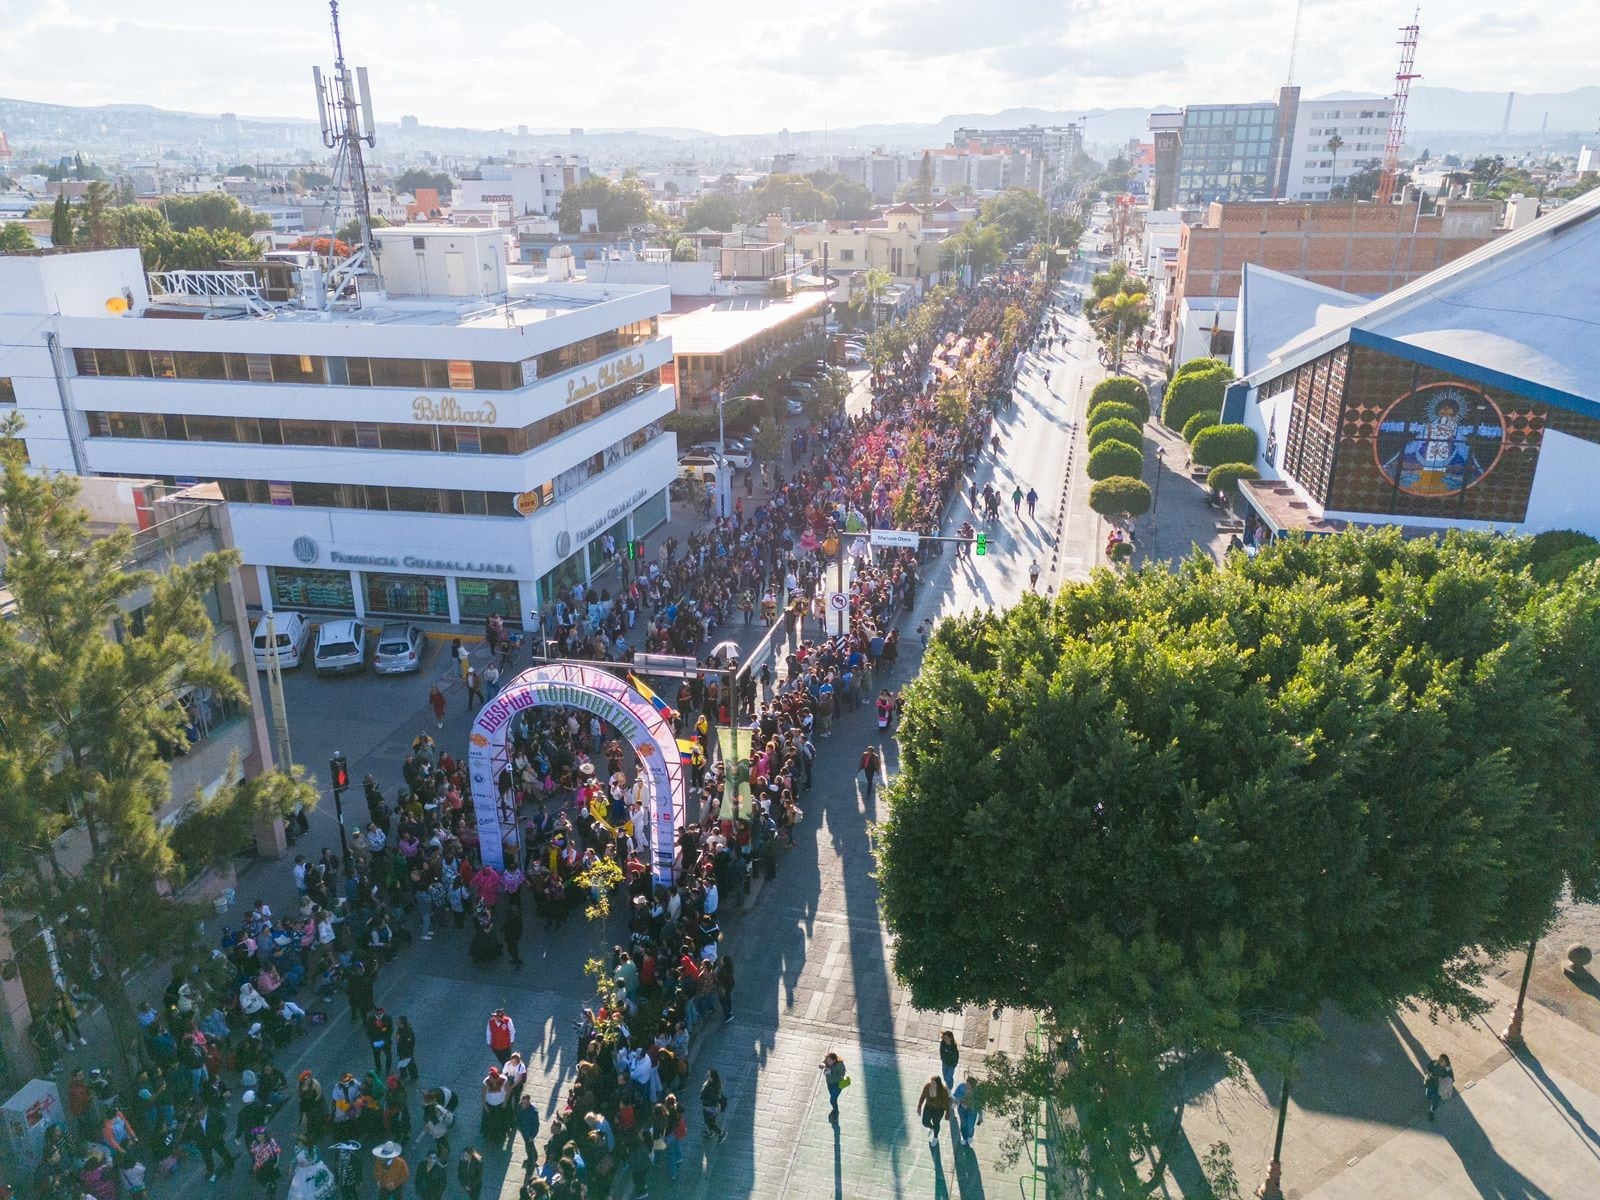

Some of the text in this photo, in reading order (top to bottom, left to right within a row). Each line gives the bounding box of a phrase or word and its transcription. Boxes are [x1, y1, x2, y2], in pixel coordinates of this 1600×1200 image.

[565, 352, 645, 405] London Club Billiard
[412, 396, 497, 426] Billiard
[877, 534, 912, 543] Mariano Otero
[478, 688, 536, 734] DESFILE
[536, 684, 638, 740] MONUMENTAL
